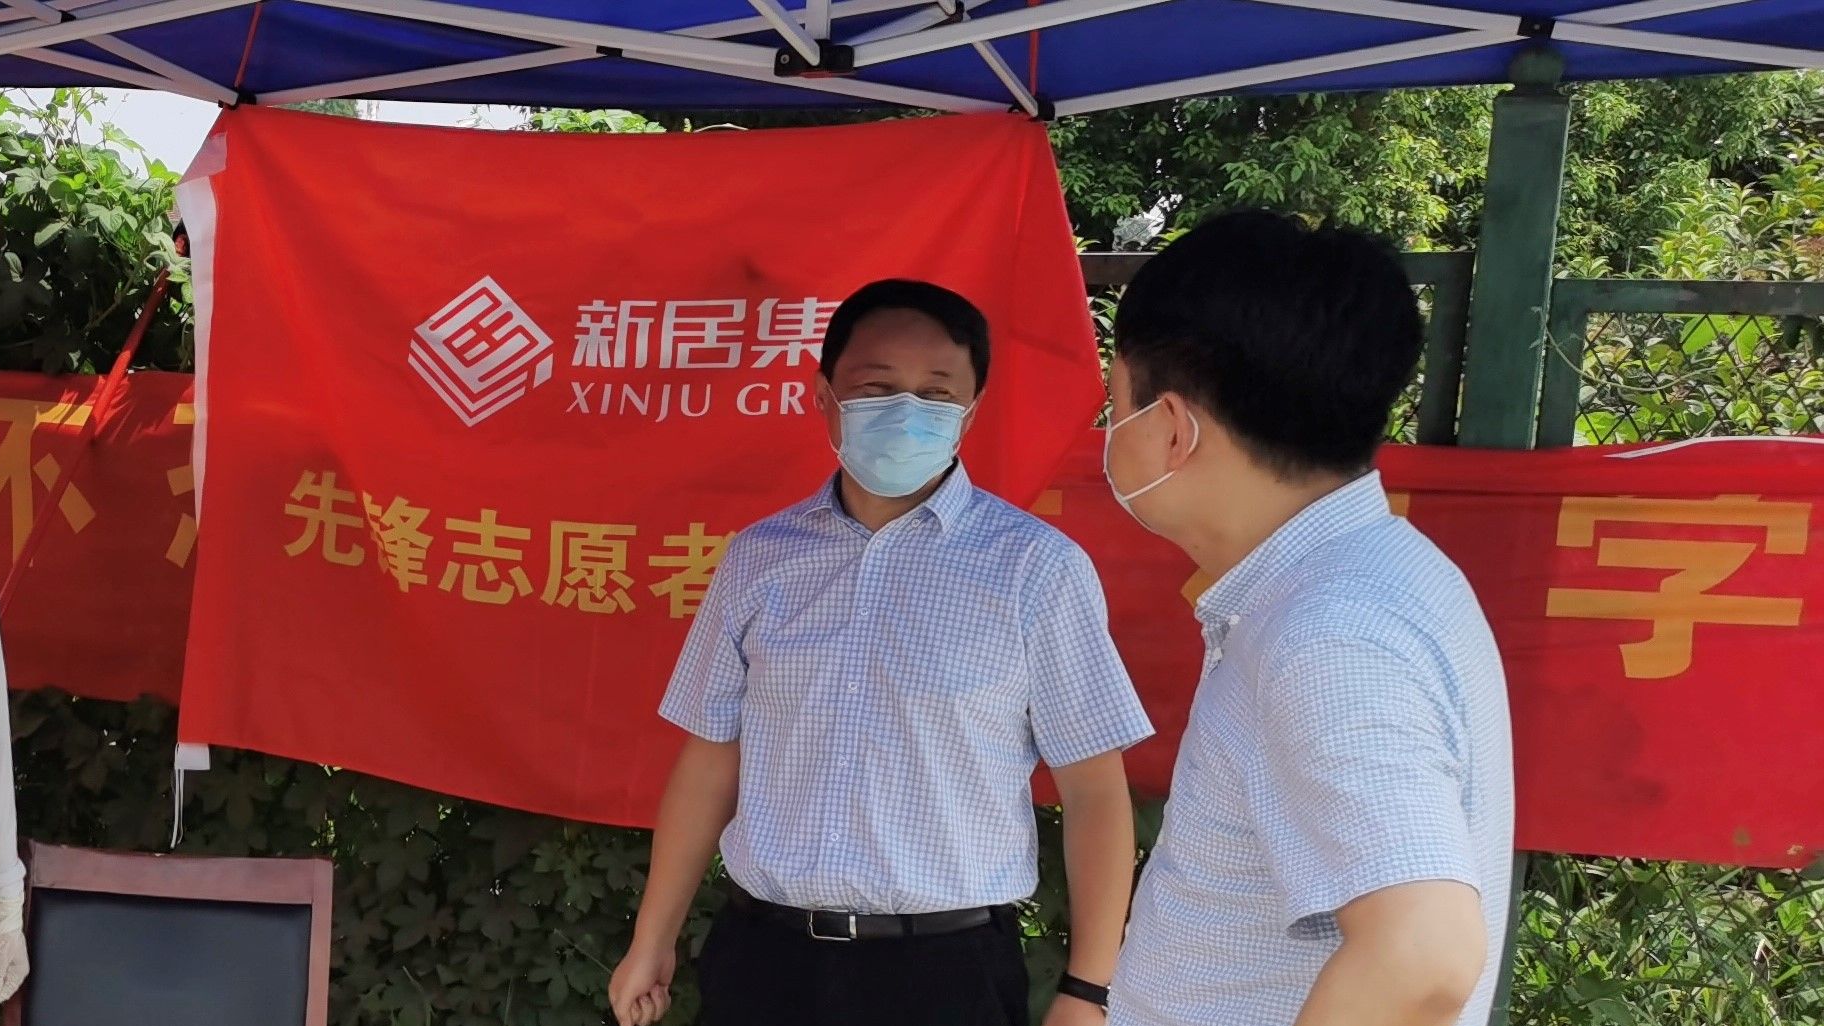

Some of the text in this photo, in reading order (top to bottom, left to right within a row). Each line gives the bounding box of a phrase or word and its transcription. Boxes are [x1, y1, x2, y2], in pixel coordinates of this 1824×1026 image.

[566, 380, 818, 423] XINJU GR
[283, 470, 737, 619] 先锋志愿者
